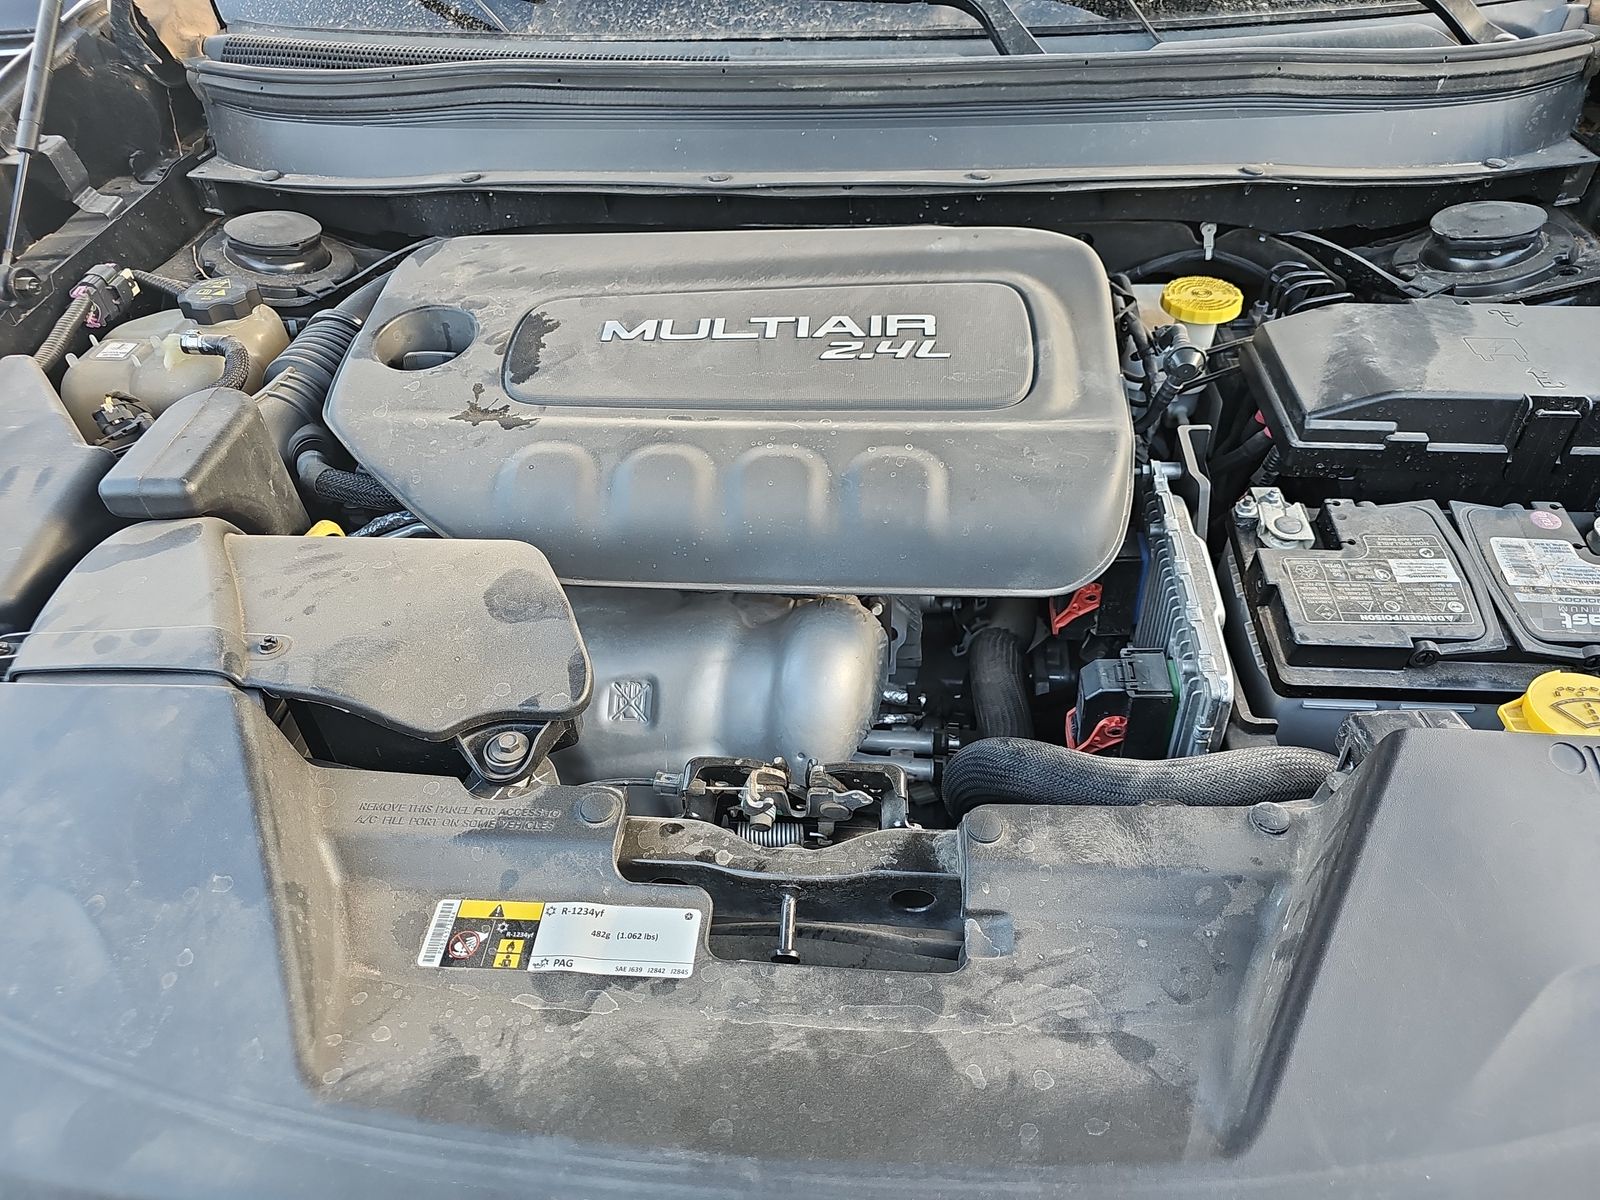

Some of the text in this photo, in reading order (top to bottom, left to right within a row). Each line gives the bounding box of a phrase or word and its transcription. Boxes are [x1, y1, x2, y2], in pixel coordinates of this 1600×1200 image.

[600, 314, 937, 342] MULTIAIR
[819, 339, 951, 360] 2.4L
[359, 802, 406, 813] REMOVE
[408, 804, 434, 814] THIS
[434, 805, 471, 815] PANEL
[472, 806, 497, 816] FOR
[498, 807, 543, 818] ACCESS
[354, 814, 556, 832] A/C FILL PORT ON SOME VEHICLES
[561, 906, 605, 919] R-1234yf
[505, 930, 535, 940] R-1234yf
[590, 929, 659, 942] 482g (1.062 lbs)
[553, 958, 574, 968] PAG
[614, 965, 628, 973] SAE
